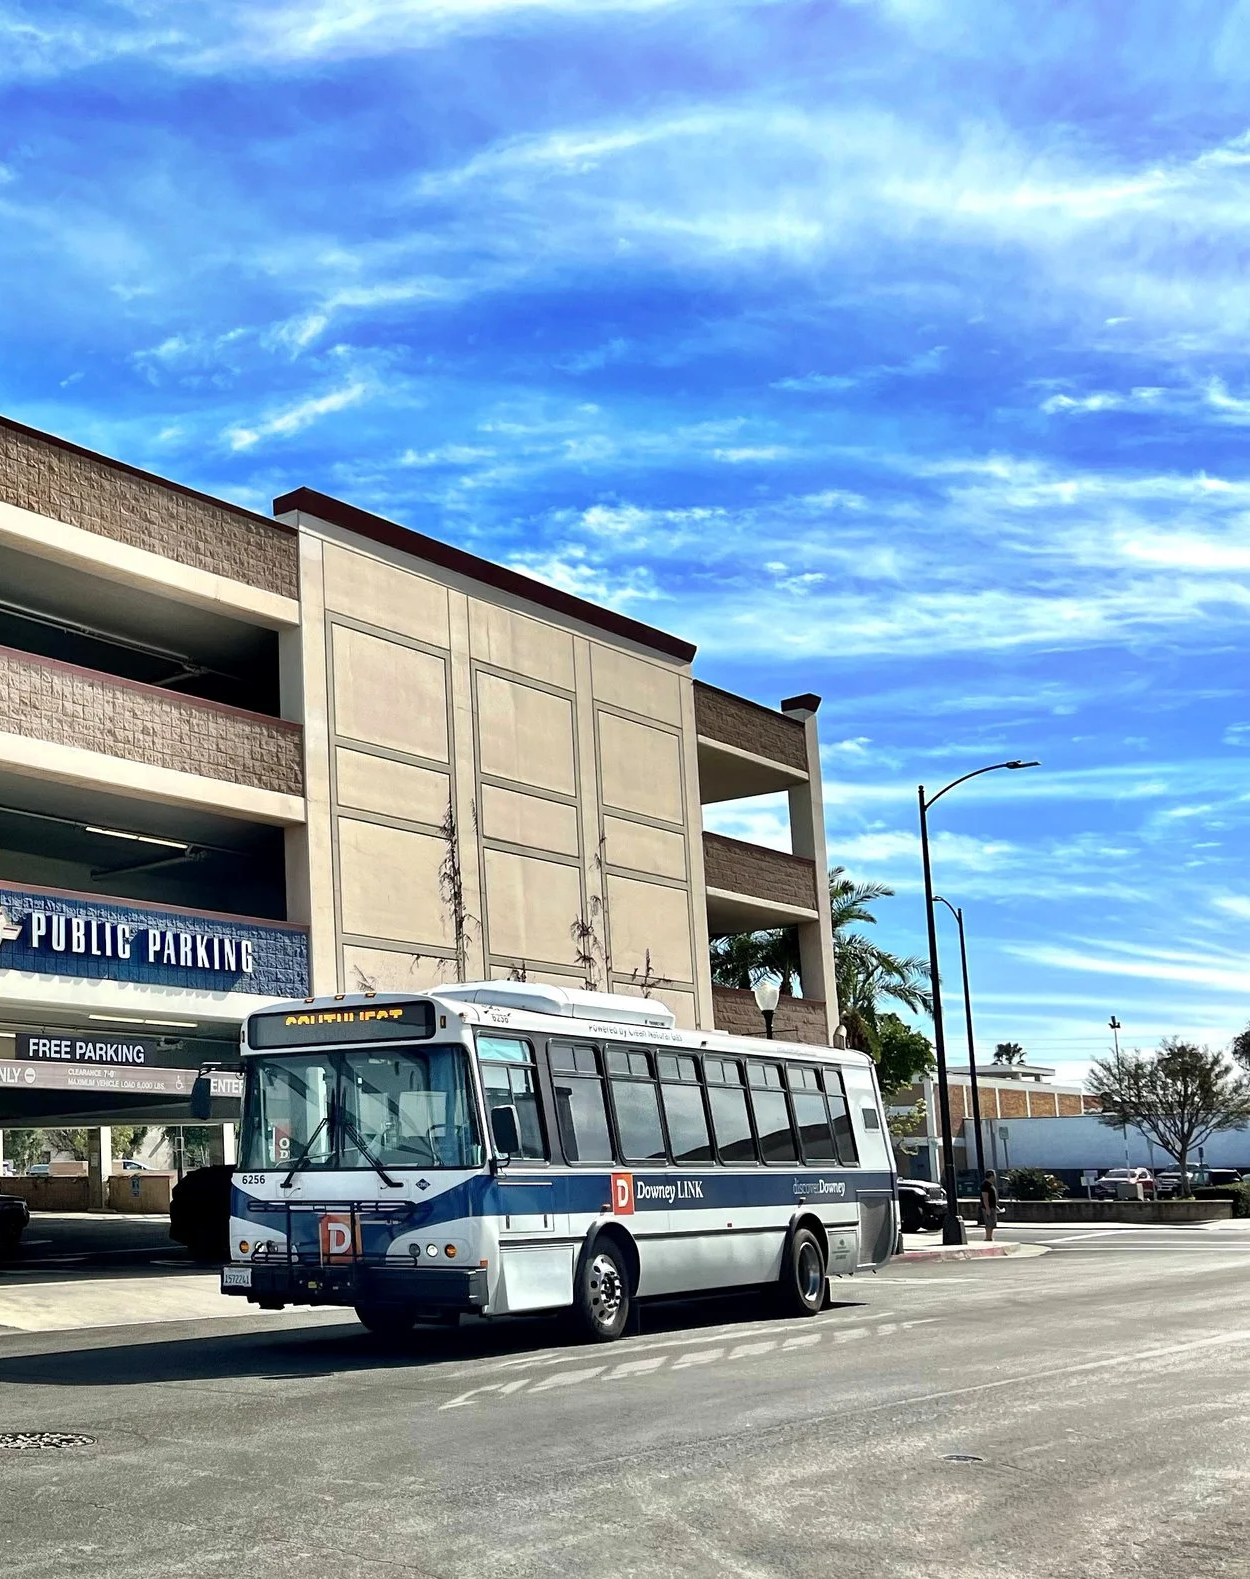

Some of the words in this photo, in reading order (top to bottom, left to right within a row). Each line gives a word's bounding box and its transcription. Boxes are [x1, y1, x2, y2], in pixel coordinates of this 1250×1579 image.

[31, 910, 131, 959] PUBLIC
[148, 928, 253, 973] PARKING
[28, 1038, 71, 1059] FREE
[75, 1041, 145, 1064] PARKING
[68, 1068, 102, 1077] CLEARANCE
[68, 1078, 95, 1086] MAXIMUM
[96, 1079, 120, 1088] VEHICLE
[120, 1080, 136, 1089] LOAD
[241, 1174, 266, 1185] 6256
[636, 1180, 676, 1204] Downey
[676, 1180, 704, 1199] LINK
[616, 1178, 629, 1208] D
[327, 1222, 352, 1254] D
